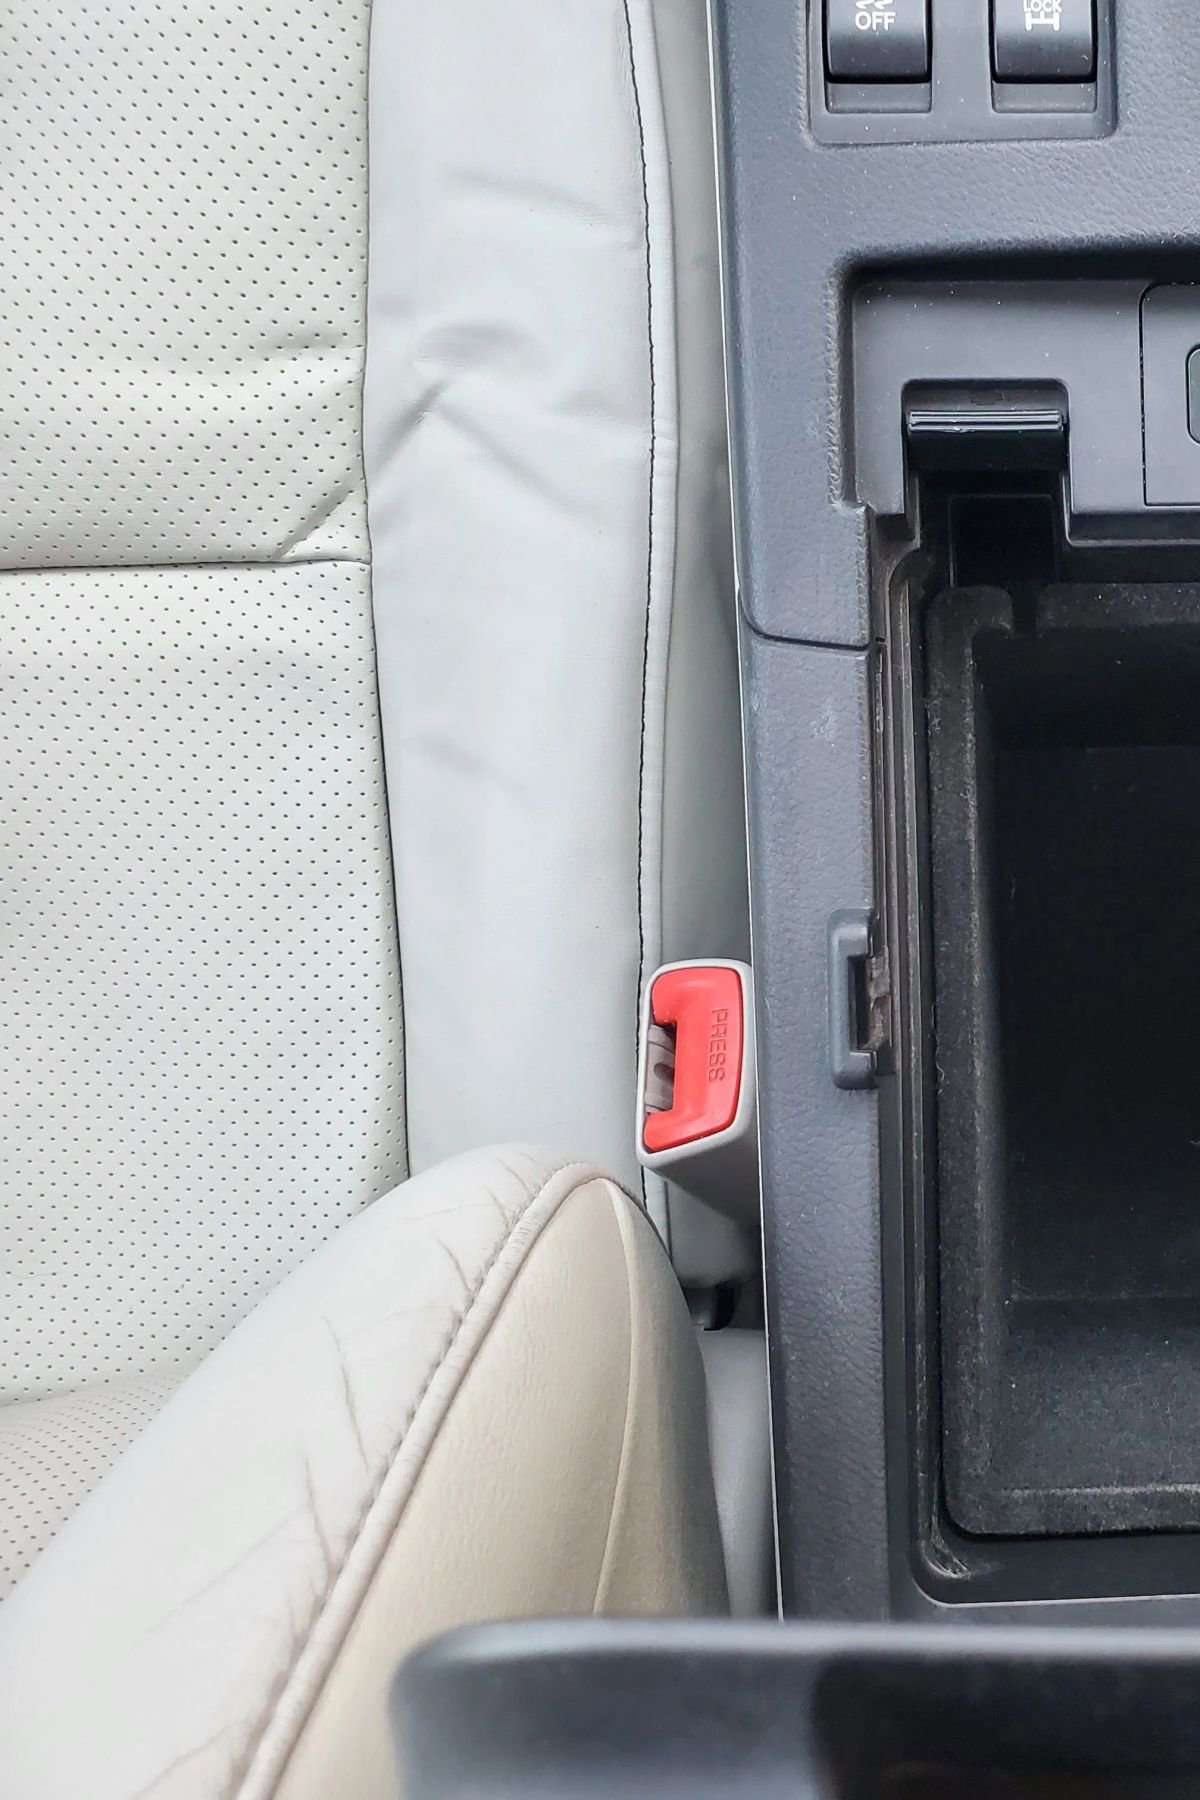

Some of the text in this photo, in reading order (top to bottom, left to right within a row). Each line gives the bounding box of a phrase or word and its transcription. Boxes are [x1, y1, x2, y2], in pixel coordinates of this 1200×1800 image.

[1023, 0, 1063, 13] LOCK
[855, 11, 896, 31] OFF
[708, 1008, 729, 1083] PRESS
